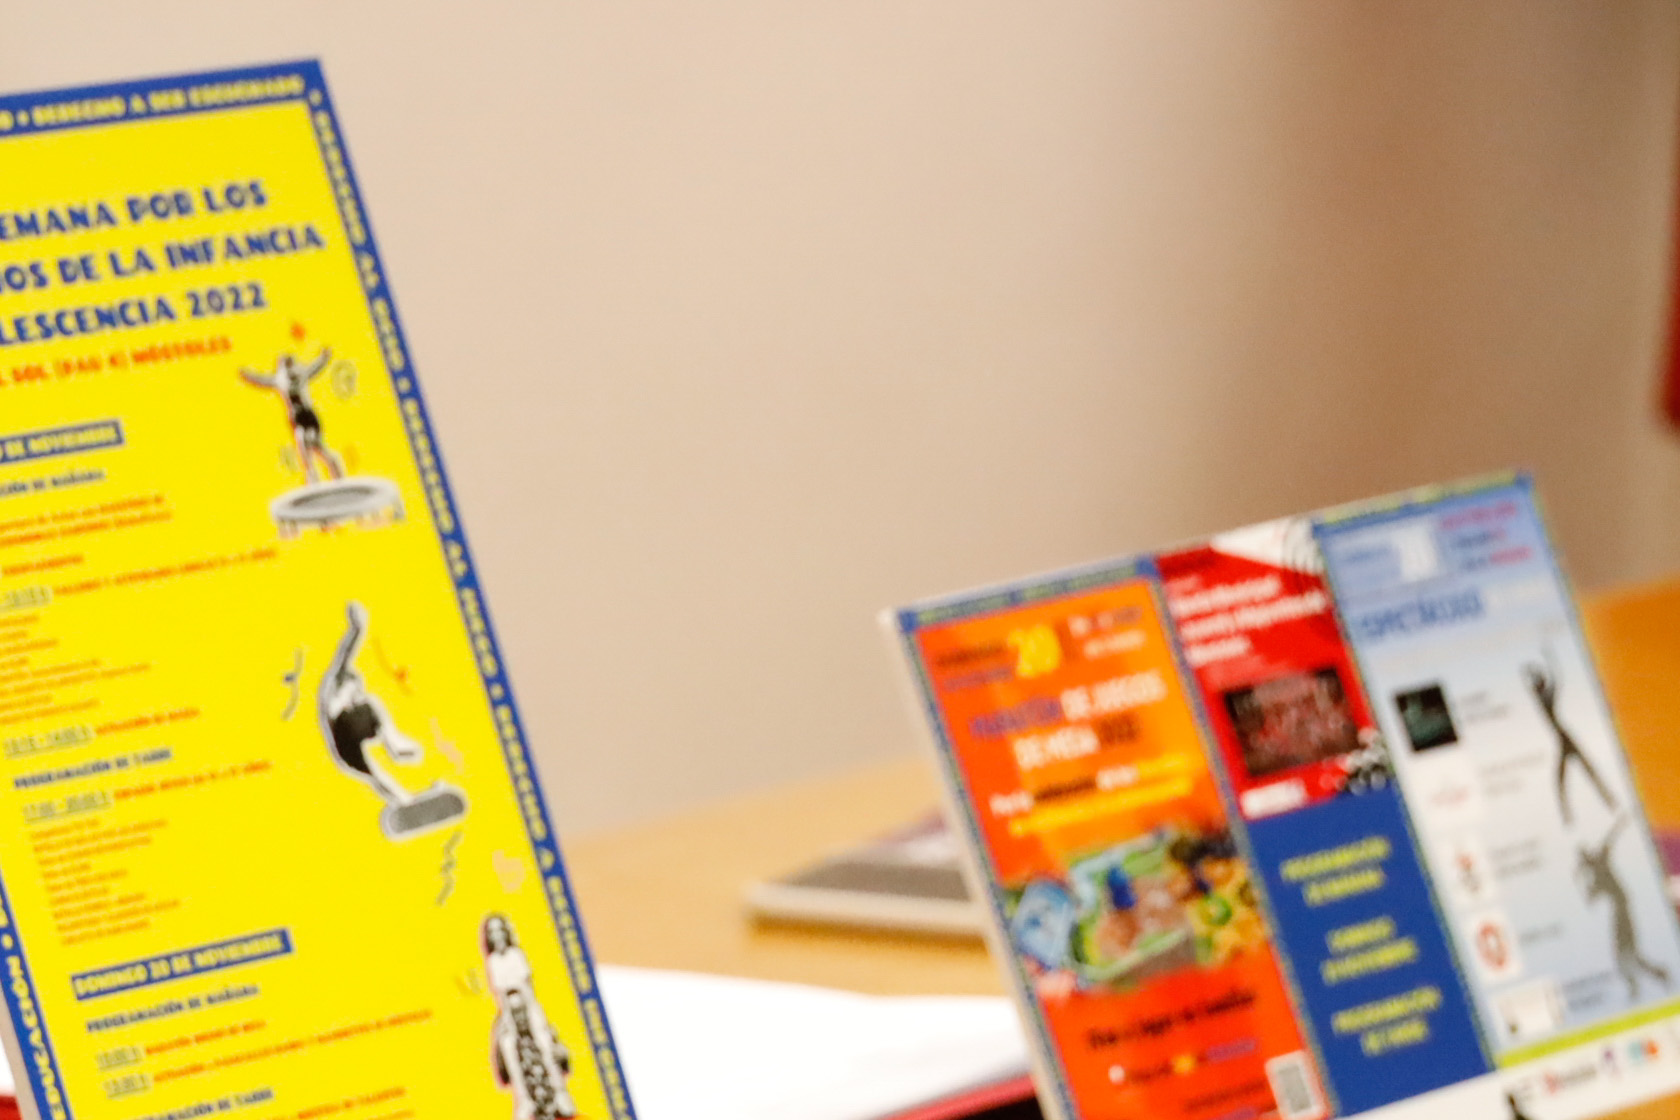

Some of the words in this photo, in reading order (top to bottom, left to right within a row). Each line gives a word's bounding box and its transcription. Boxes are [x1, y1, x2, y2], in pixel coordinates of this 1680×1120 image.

[124, 189, 196, 224] POR
[200, 179, 269, 214] LOS
[55, 254, 101, 285] DE
[108, 247, 156, 278] LA
[163, 224, 326, 270] INFANCIA
[183, 282, 269, 319] 2022
